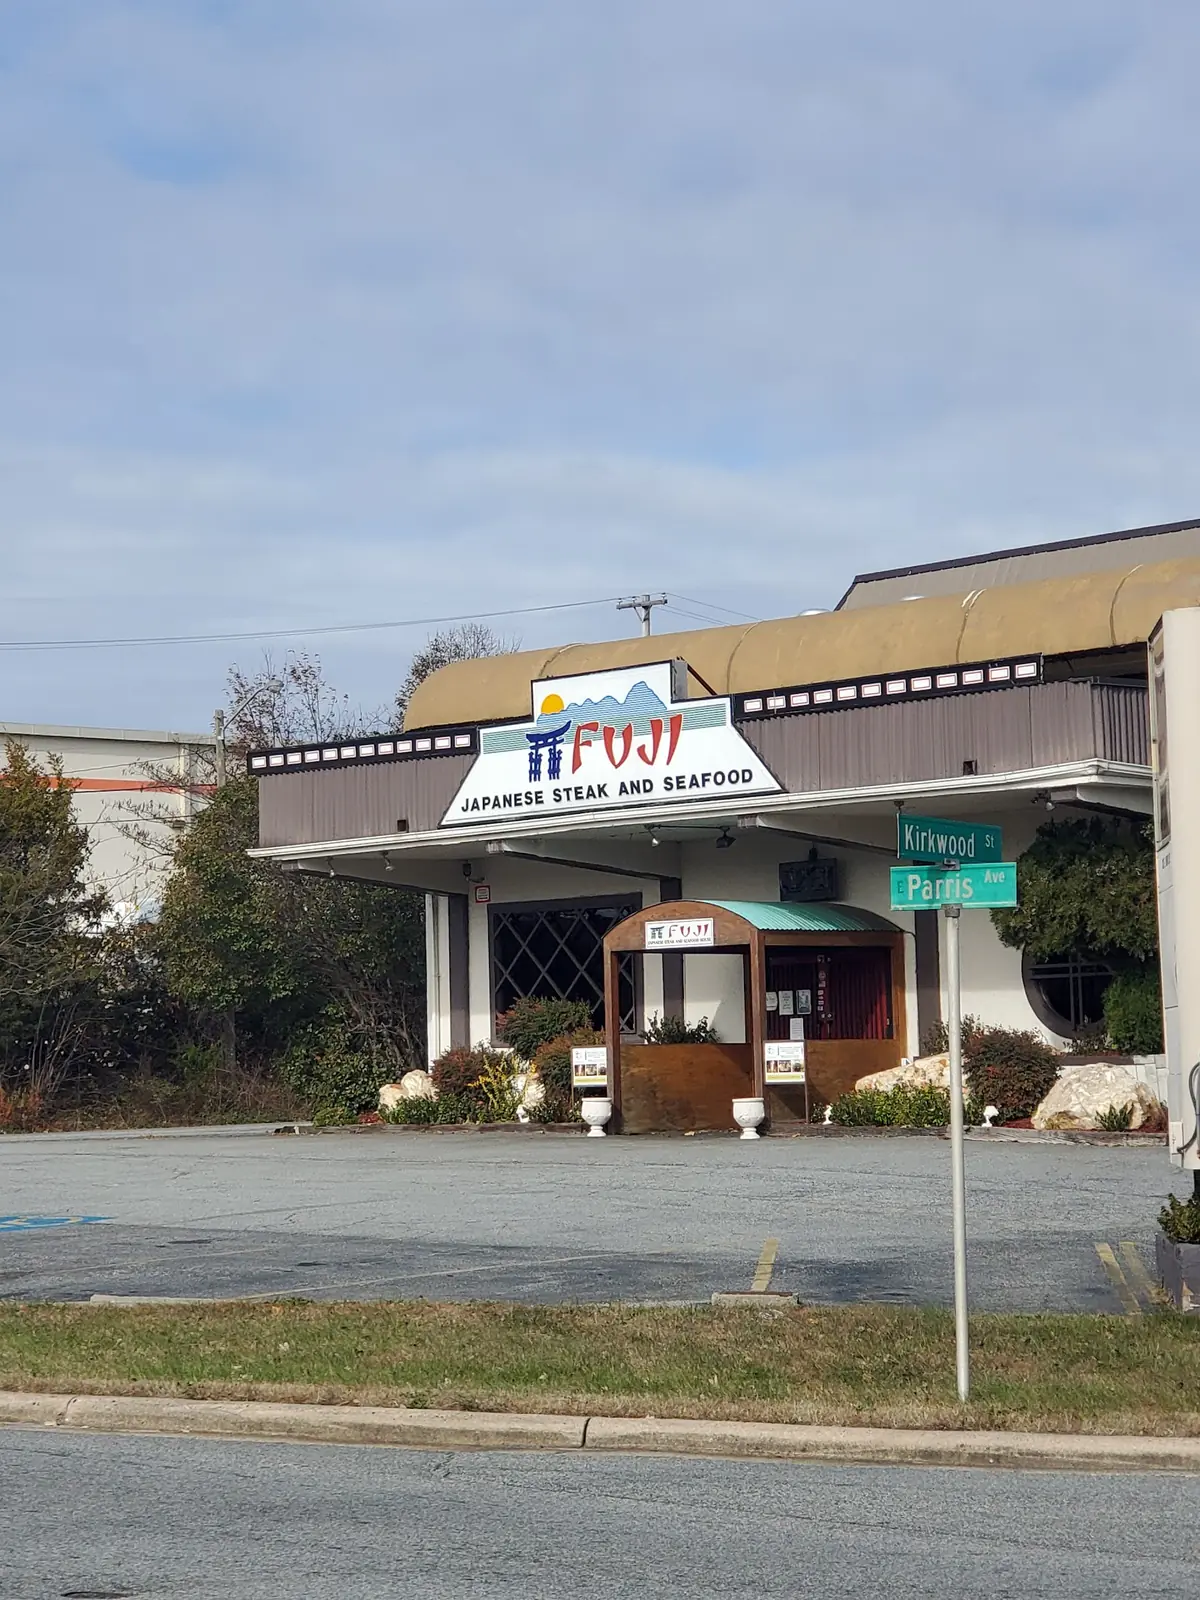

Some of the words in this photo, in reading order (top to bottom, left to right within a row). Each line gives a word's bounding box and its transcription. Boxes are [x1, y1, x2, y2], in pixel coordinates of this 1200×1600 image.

[572, 713, 683, 774] FUJI
[461, 790, 545, 812] JAPANESE
[552, 783, 609, 803] STEAK
[618, 778, 654, 796] AND
[663, 768, 754, 791] SEAFOOD
[904, 824, 975, 857] Kirkwood
[985, 834, 995, 848] St
[897, 881, 903, 894] E
[907, 872, 974, 901] Parris
[984, 869, 1005, 884] Ave
[669, 924, 708, 938] FUJI
